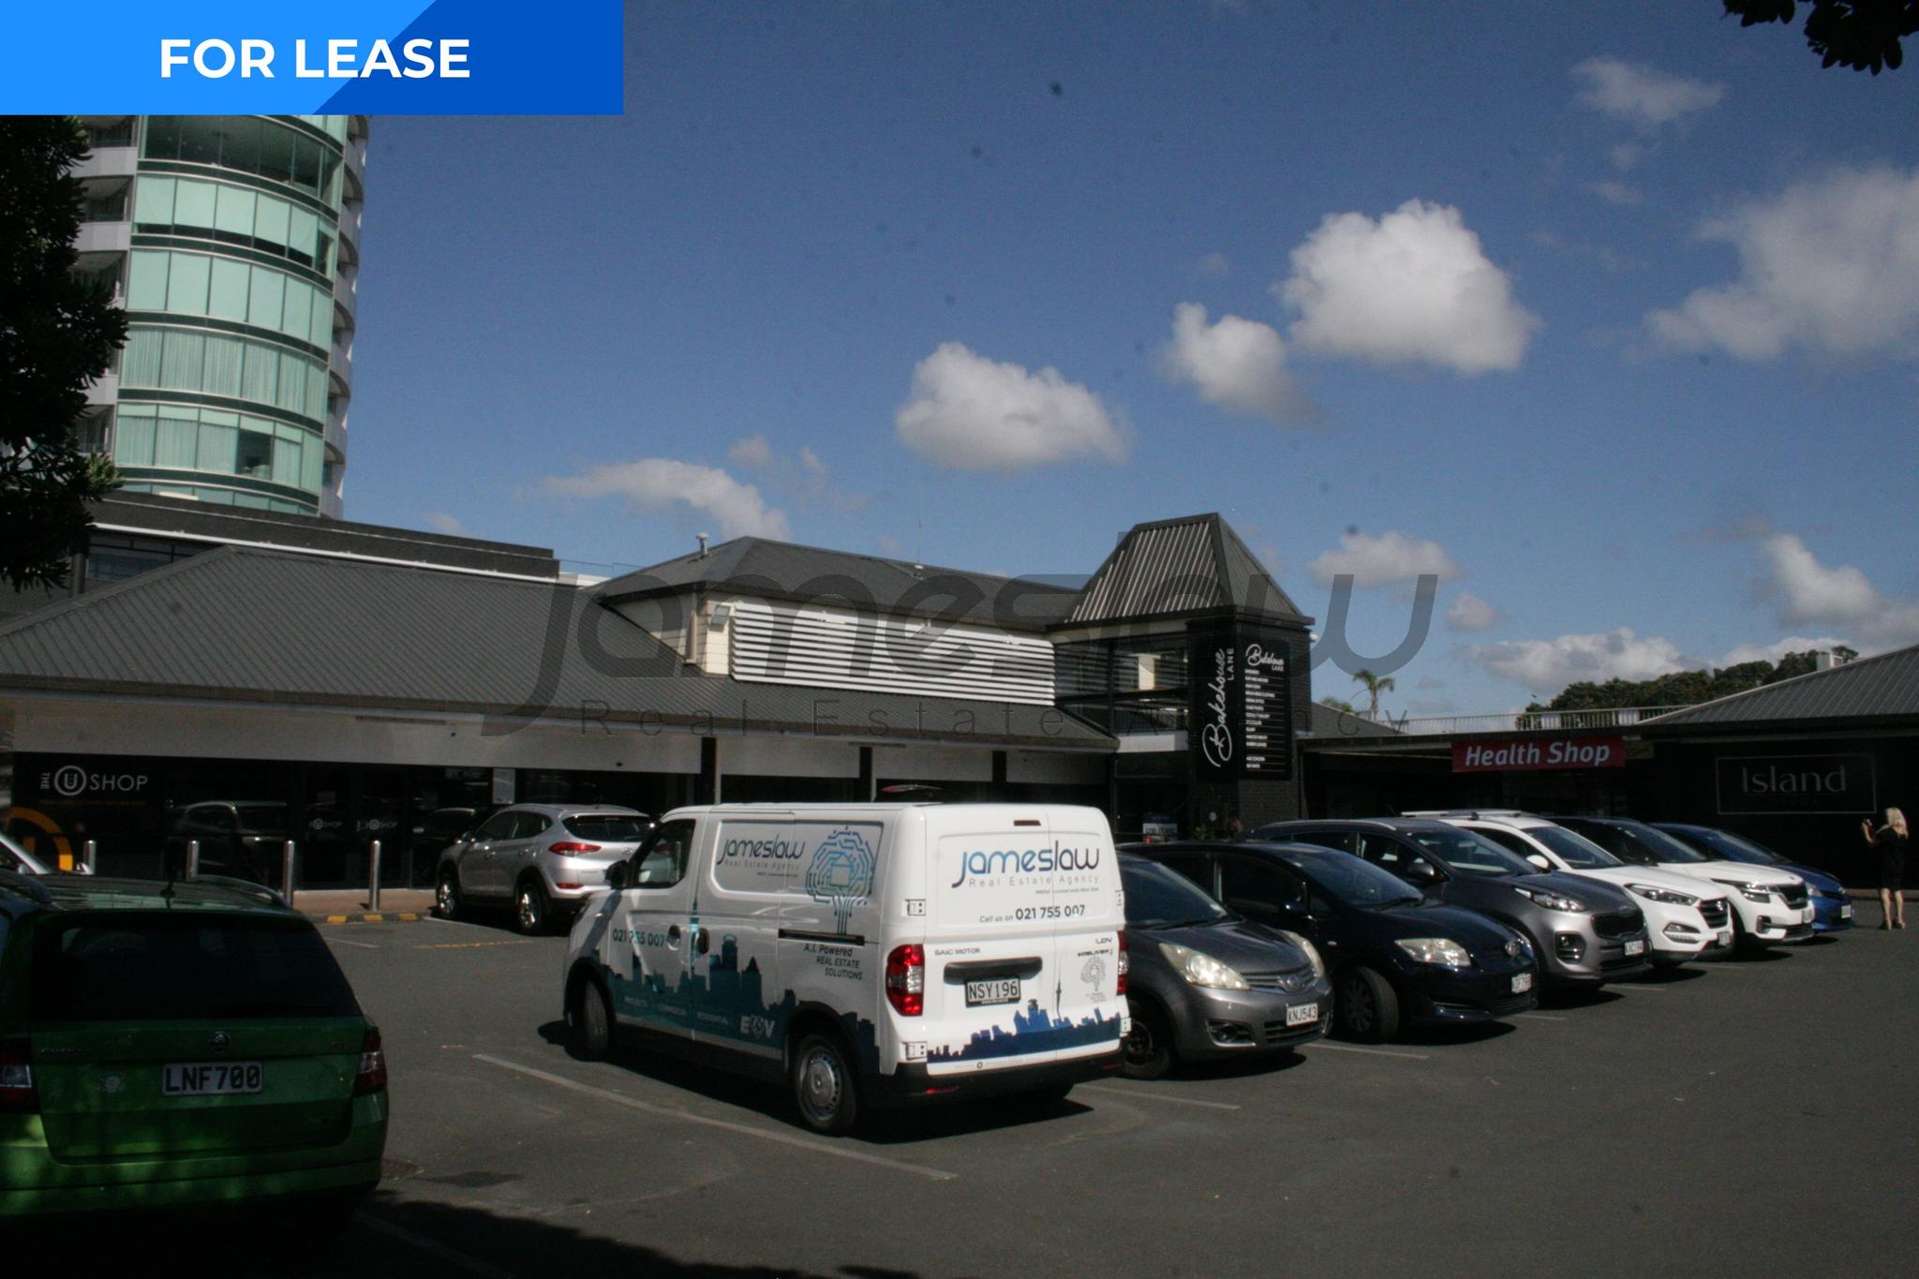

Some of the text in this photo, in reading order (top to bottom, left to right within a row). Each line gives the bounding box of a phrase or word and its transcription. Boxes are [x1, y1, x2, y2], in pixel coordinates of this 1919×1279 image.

[1226, 647, 1234, 681] LANE
[1201, 648, 1232, 768] Bakehouse
[1465, 740, 1611, 767] Health Shop
[39, 771, 149, 792] THE U SHOP
[1740, 764, 1848, 793] Island
[716, 833, 806, 866] jameslaw
[951, 840, 1100, 889] jameslaw
[968, 875, 1100, 887] Real Estate Agency
[979, 914, 994, 923] Call
[1005, 914, 1014, 922] on
[1015, 908, 1037, 921] 021
[1040, 906, 1061, 919] 755
[1064, 904, 1086, 918] 007
[816, 955, 860, 969] REAL ESTATE
[955, 947, 981, 955] MOTOR
[824, 967, 863, 981] SOLUTIONS
[968, 980, 1018, 999] NSY196
[165, 1064, 260, 1093] LNF700
